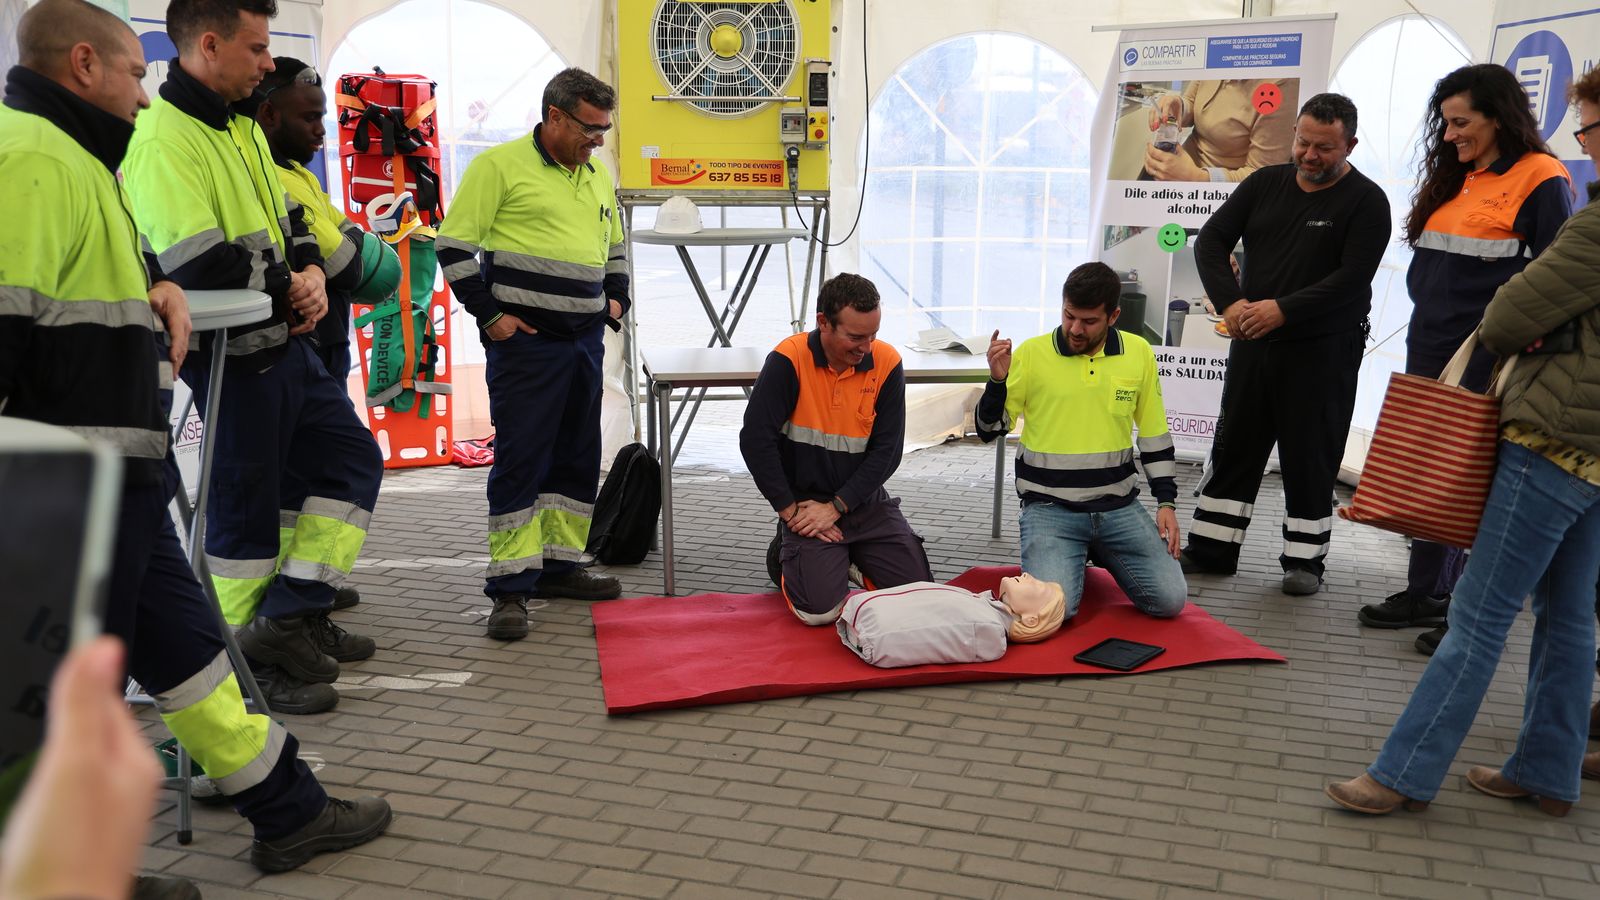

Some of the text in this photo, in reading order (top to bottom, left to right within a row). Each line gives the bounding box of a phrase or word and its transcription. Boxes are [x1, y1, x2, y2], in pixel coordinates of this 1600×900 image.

[1142, 44, 1196, 59] COMPARTIR
[661, 163, 690, 172] Bernal
[709, 172, 782, 183] 637 85 55 18
[1124, 188, 1231, 200] Dile adiós al taba
[1167, 204, 1215, 215] alcohol.
[376, 343, 390, 384] DEVICE
[1153, 353, 1229, 368] ate a un est
[1158, 366, 1226, 382] ás SALUDA
[180, 421, 202, 442] NSE
[1166, 417, 1215, 435] EGURIDA
